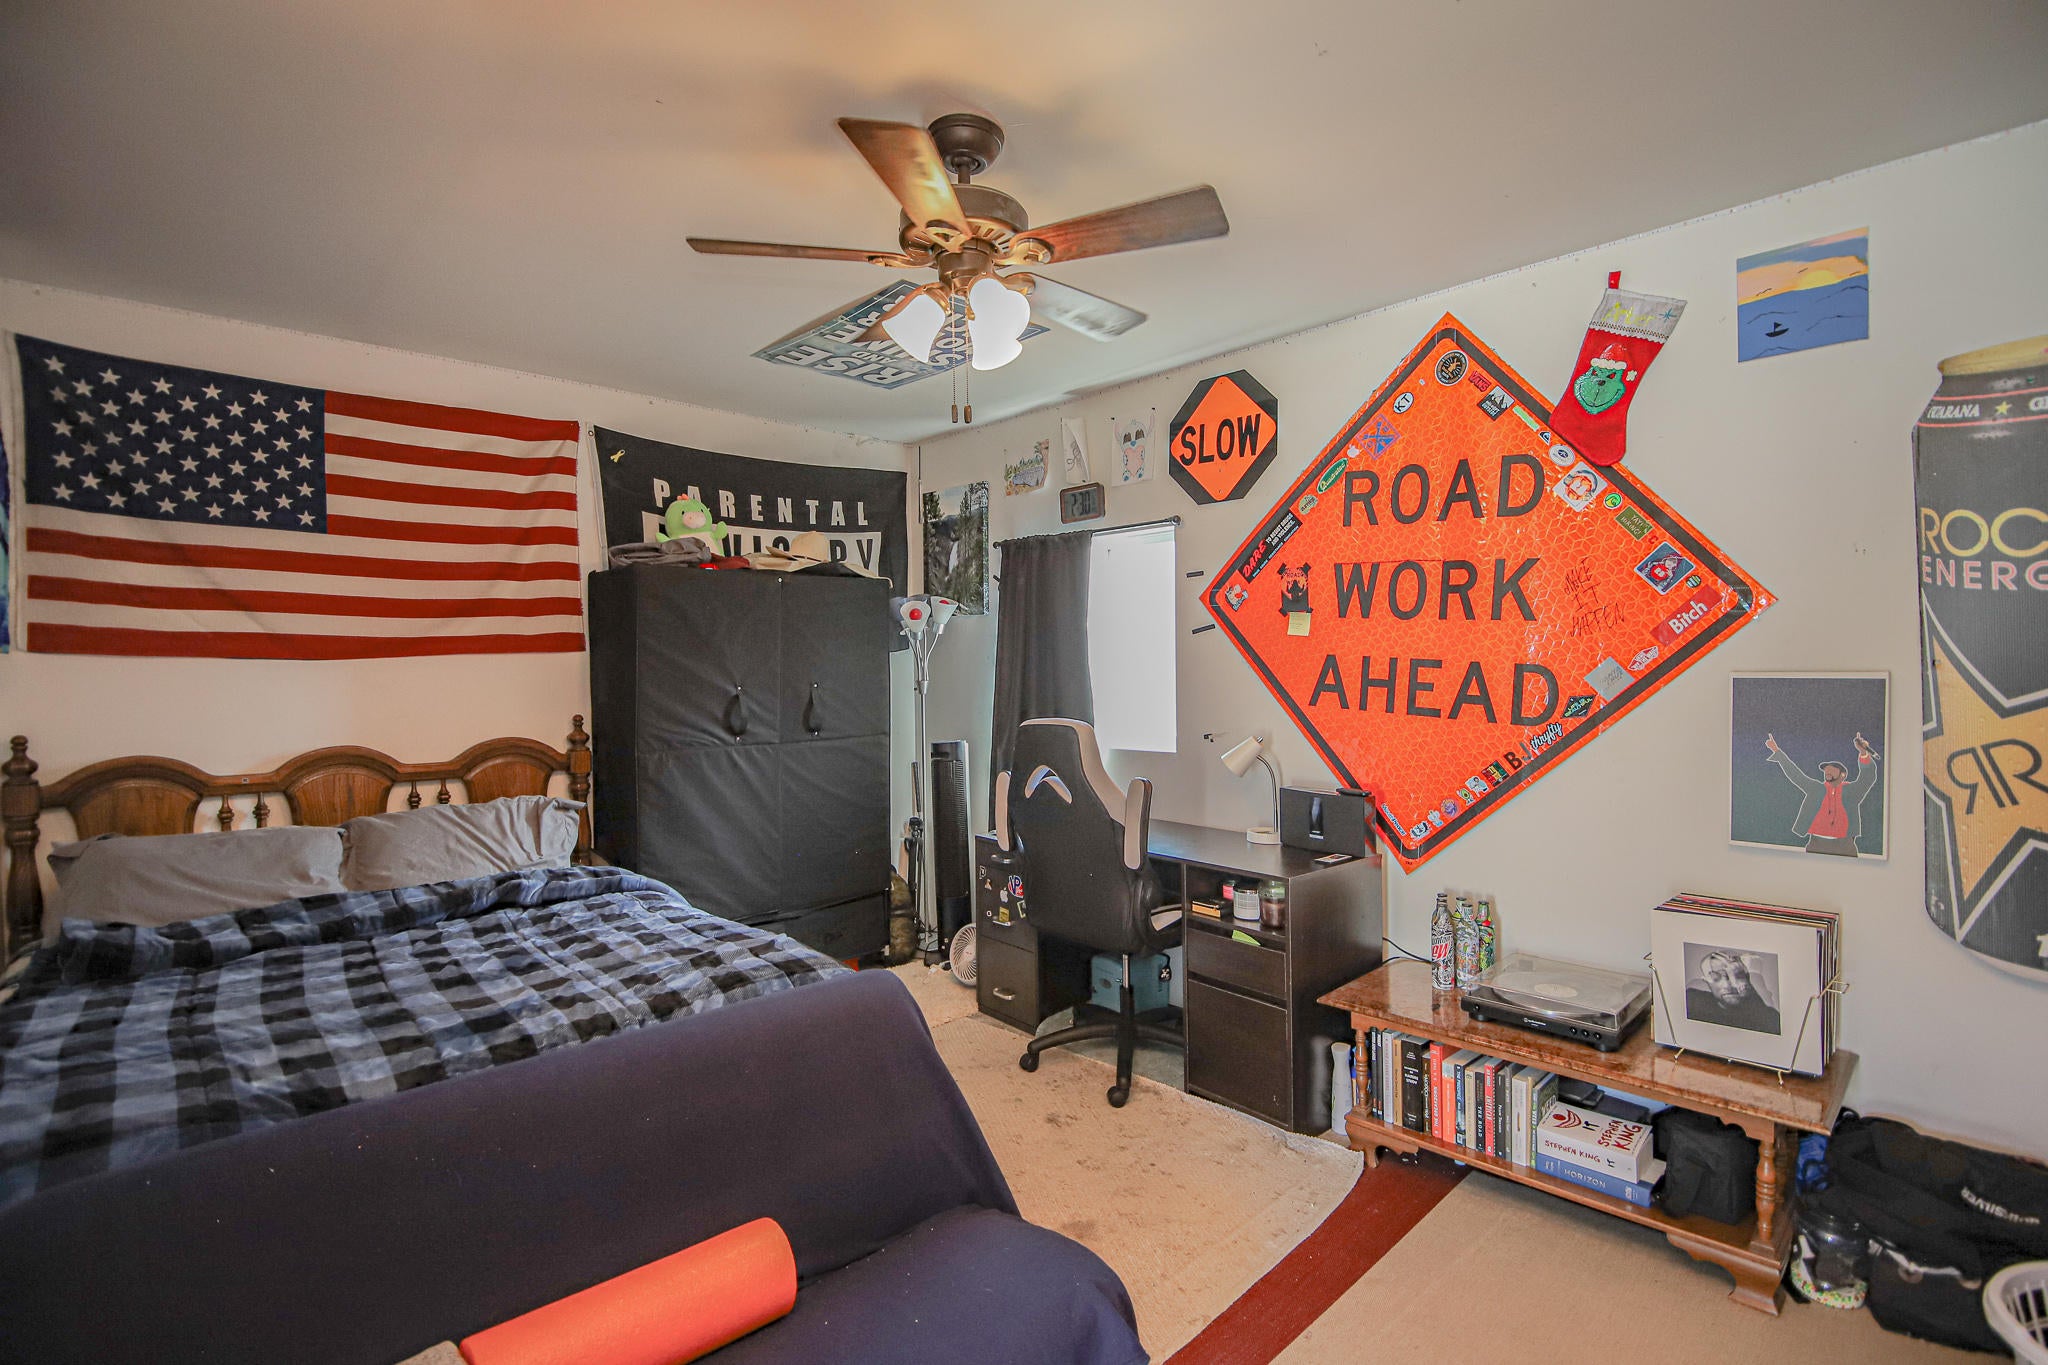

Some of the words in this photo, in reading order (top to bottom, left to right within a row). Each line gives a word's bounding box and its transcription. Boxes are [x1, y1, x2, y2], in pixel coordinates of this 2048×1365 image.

[775, 345, 914, 385] RISE
[850, 350, 892, 363] AND
[1179, 413, 1261, 466] SLOW
[653, 478, 869, 526] PARENTAL
[1343, 453, 1545, 527] ROAD
[1920, 507, 2048, 557] ROC
[1334, 557, 1541, 621] WORK
[1668, 601, 1708, 635] Bitch
[1308, 654, 1560, 727] AHEAD
[1544, 1140, 1577, 1155] STEPHEN
[1579, 1150, 1601, 1163] KING
[1598, 1120, 1623, 1147] STEPHEN
[1611, 1124, 1643, 1151] KING
[1564, 1169, 1606, 1189] HORIZON
